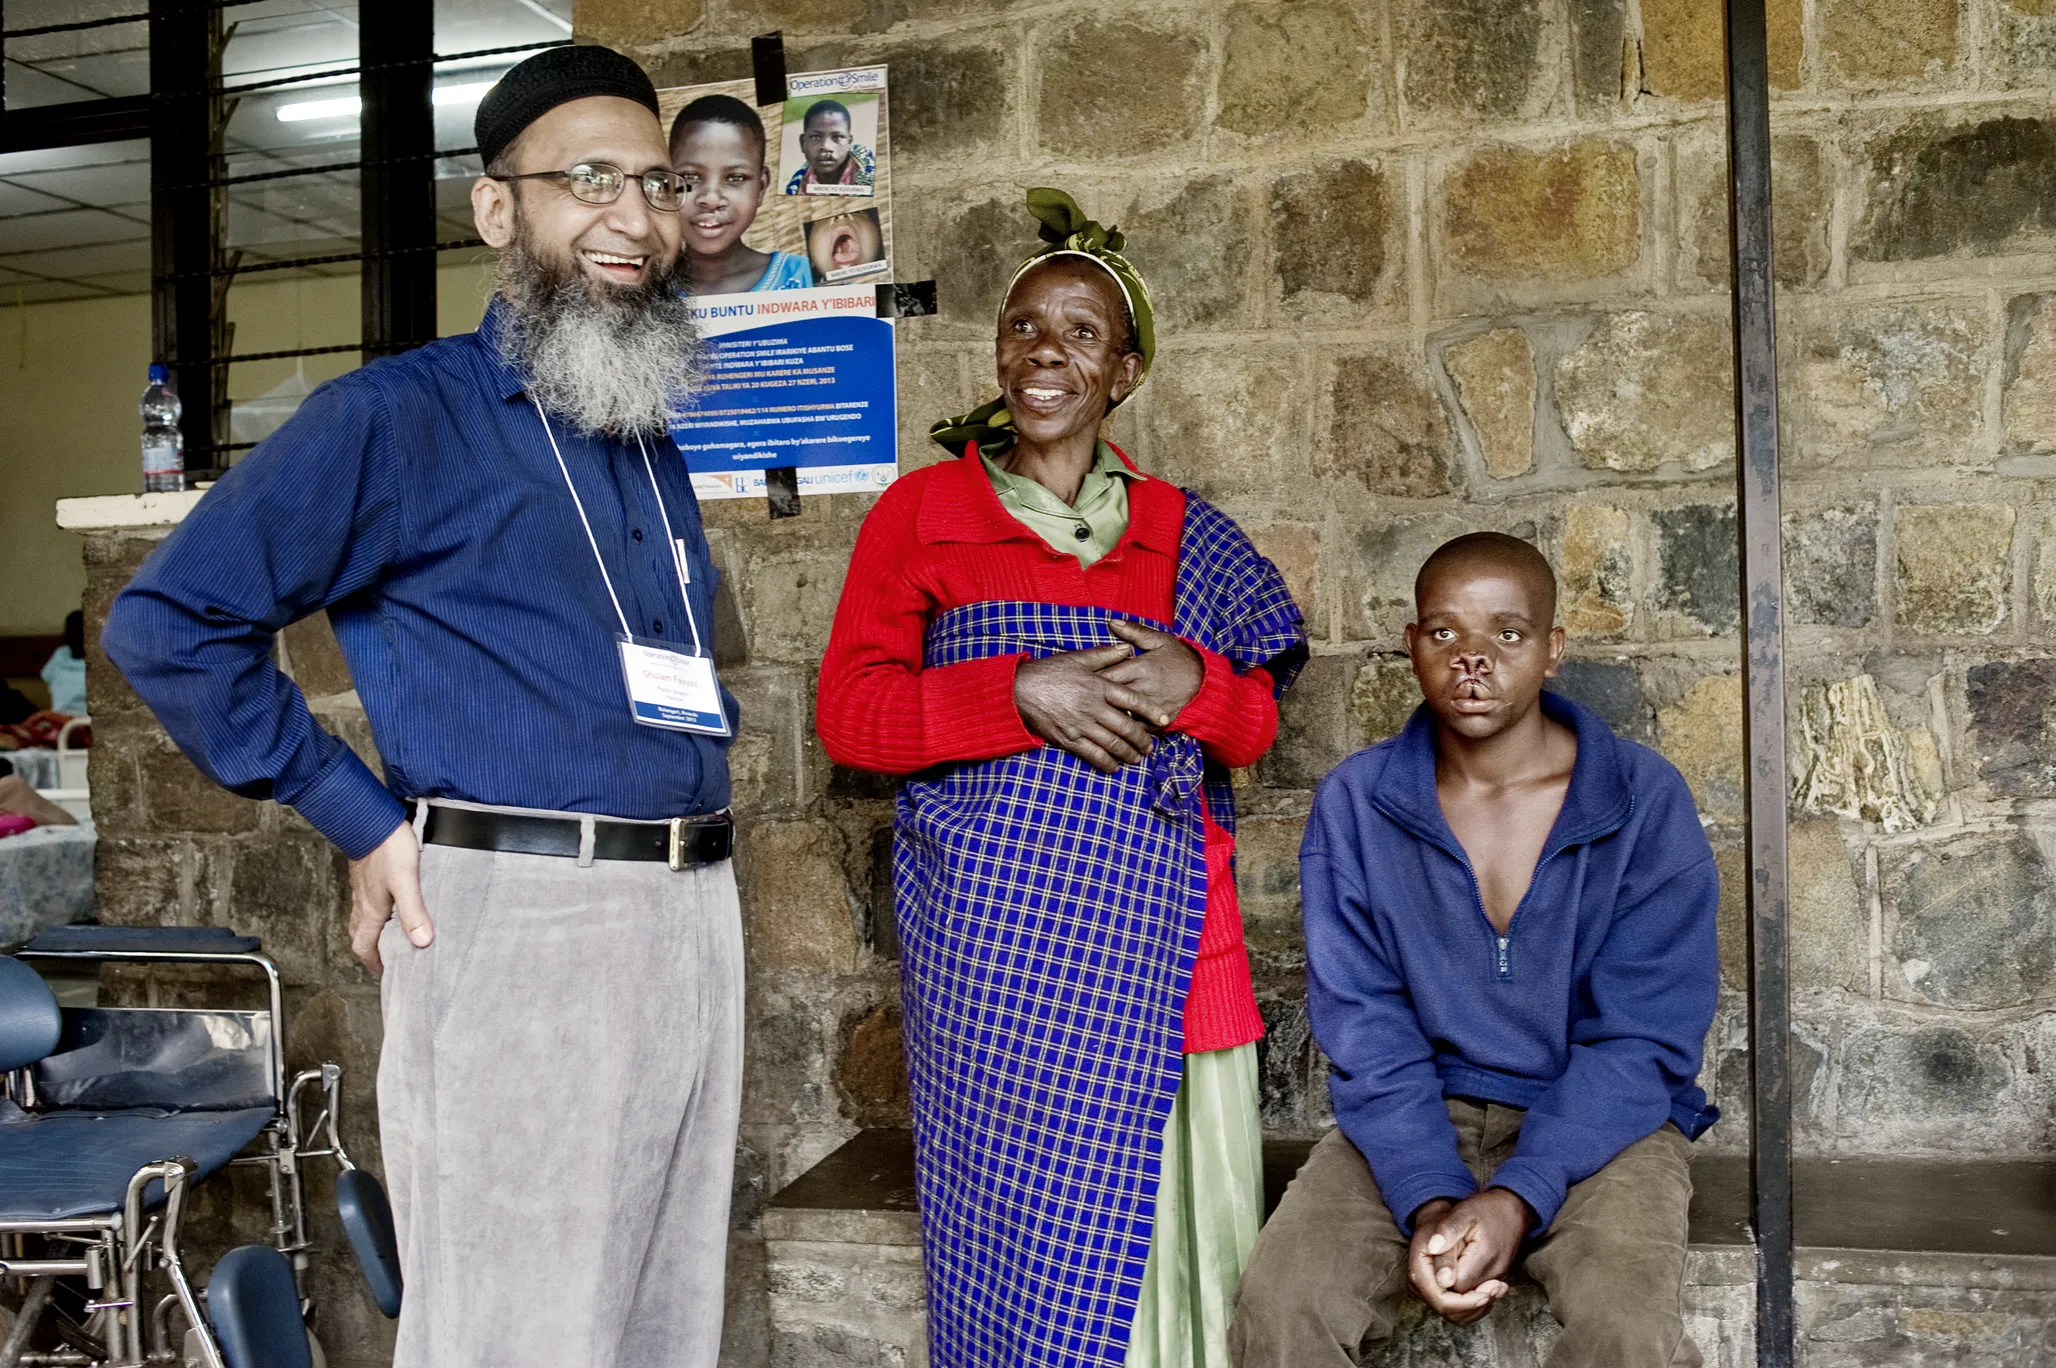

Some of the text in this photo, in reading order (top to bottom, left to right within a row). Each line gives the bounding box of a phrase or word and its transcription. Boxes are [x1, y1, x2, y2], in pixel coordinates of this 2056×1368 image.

[790, 71, 878, 92] Operation Smile
[711, 304, 754, 318] BUNTU
[757, 300, 818, 315] INDWARA
[821, 296, 876, 310] Y'IBIBARI
[720, 351, 755, 360] OPERATION
[756, 349, 774, 357] SMILE
[808, 345, 835, 354] ABANTU
[836, 344, 854, 352] BOSE
[723, 361, 754, 369] INDWARA
[785, 357, 804, 365] KUZA
[717, 371, 753, 380] RUHENGERI
[754, 370, 766, 378] MU
[766, 369, 791, 378] KARERE
[792, 368, 802, 376] KA
[803, 366, 836, 375] MUSANZE
[742, 381, 750, 389] YA
[760, 380, 787, 388] KUGEZA
[819, 376, 836, 385] 2013
[769, 405, 796, 413] NUMERO
[835, 401, 868, 409] BITARENZE
[781, 415, 814, 424] UBUFASHA
[702, 442, 746, 452] guhamagara,
[747, 441, 766, 449] egera
[767, 438, 790, 447] ibitaro
[791, 437, 826, 447] by'akarere
[827, 435, 871, 444] bikwegereye
[732, 451, 777, 462] wiyandikishe
[815, 469, 852, 485] unicef
[643, 669, 699, 687] Ghulam Fayyaz
[661, 712, 685, 721] September
